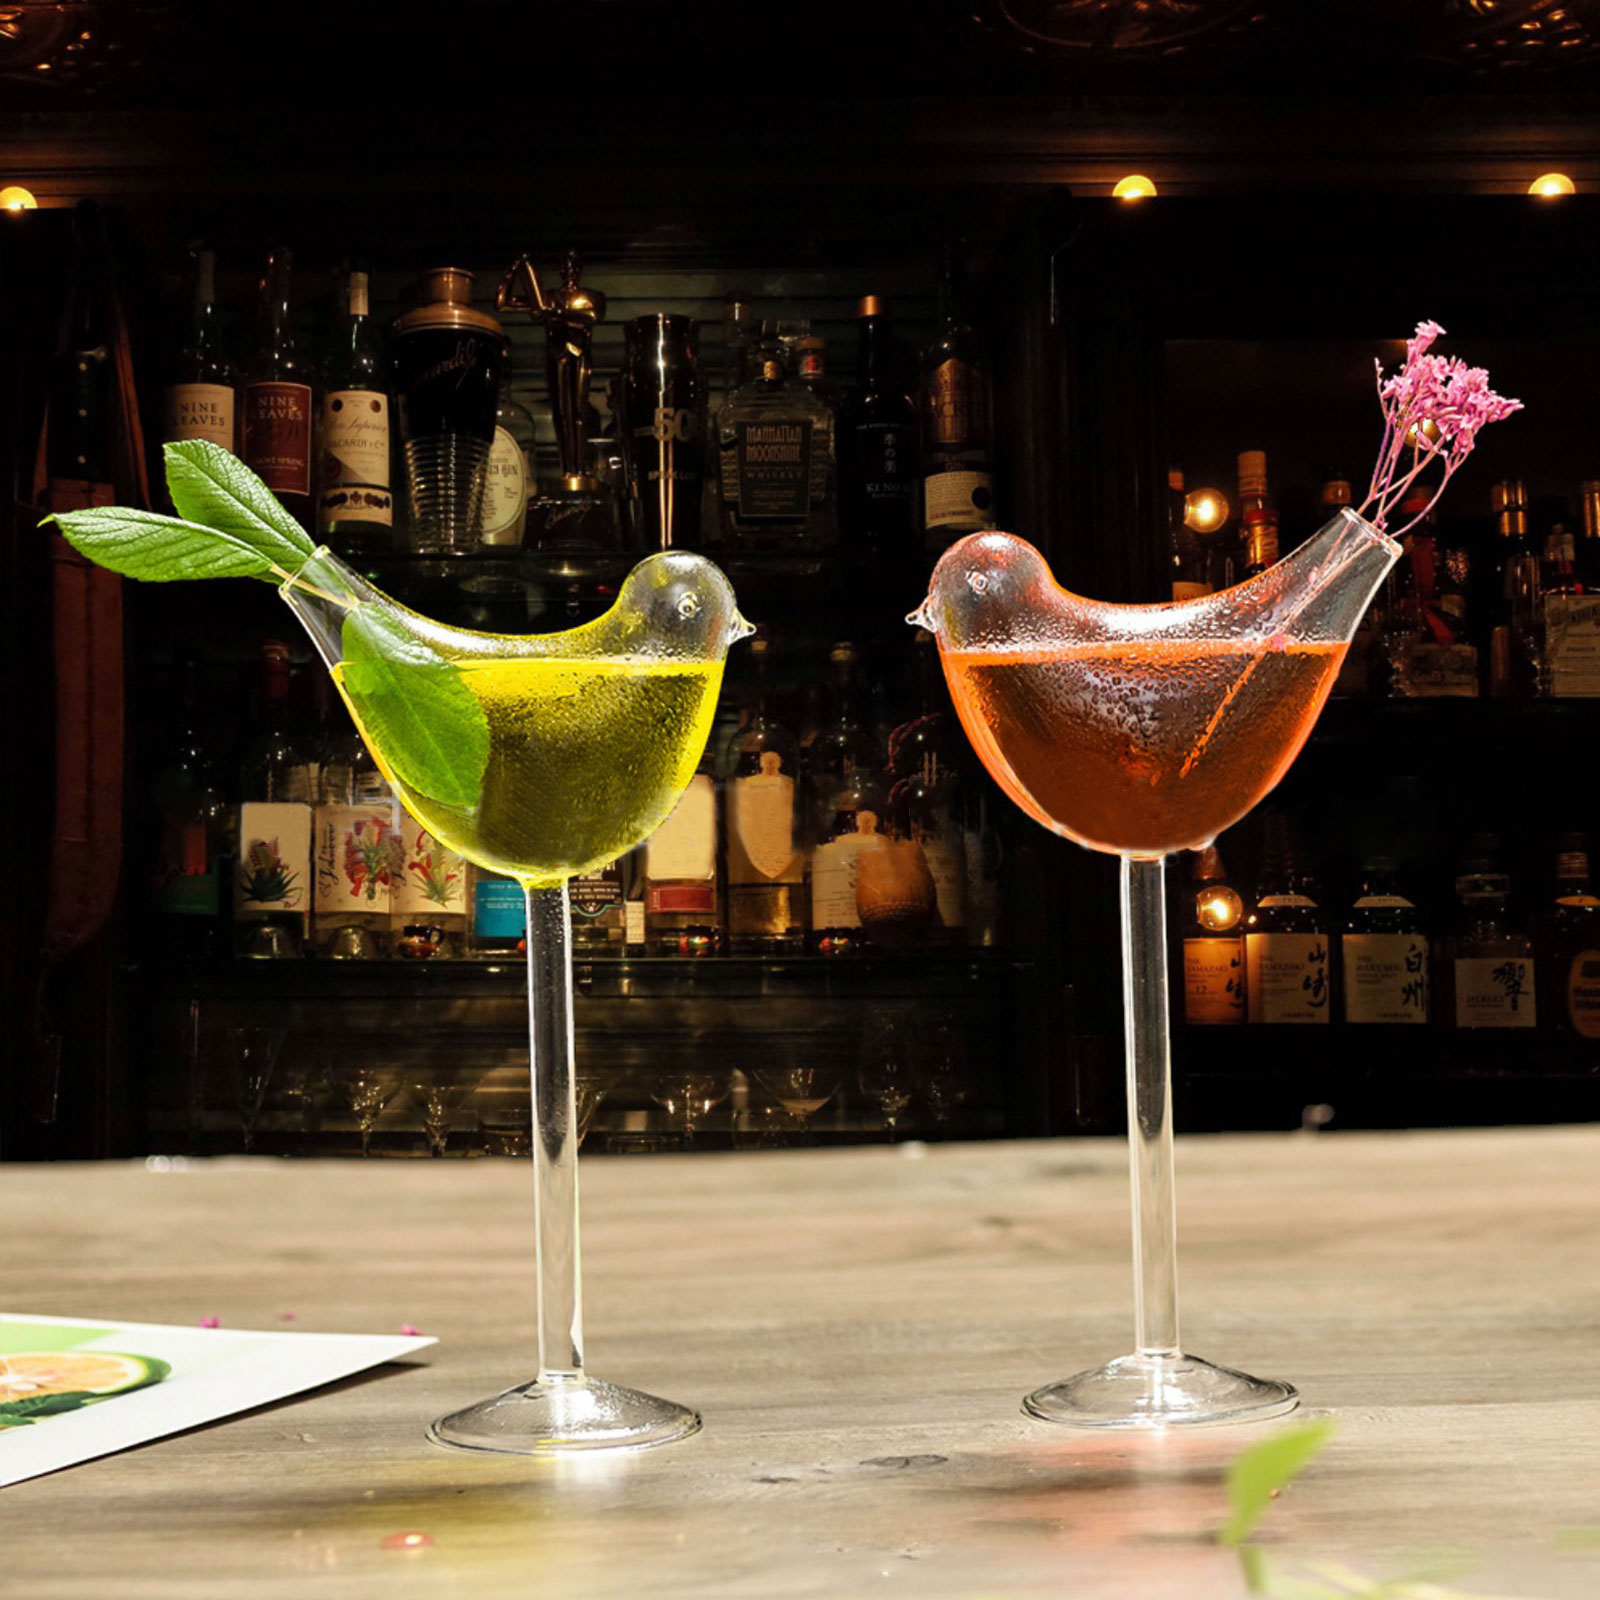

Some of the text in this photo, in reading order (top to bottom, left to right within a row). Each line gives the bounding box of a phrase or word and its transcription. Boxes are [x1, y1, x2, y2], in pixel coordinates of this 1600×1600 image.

[258, 396, 297, 407] NINE
[181, 402, 218, 414] NINE
[256, 408, 303, 420] EAVES
[1401, 942, 1425, 1011] 白州
